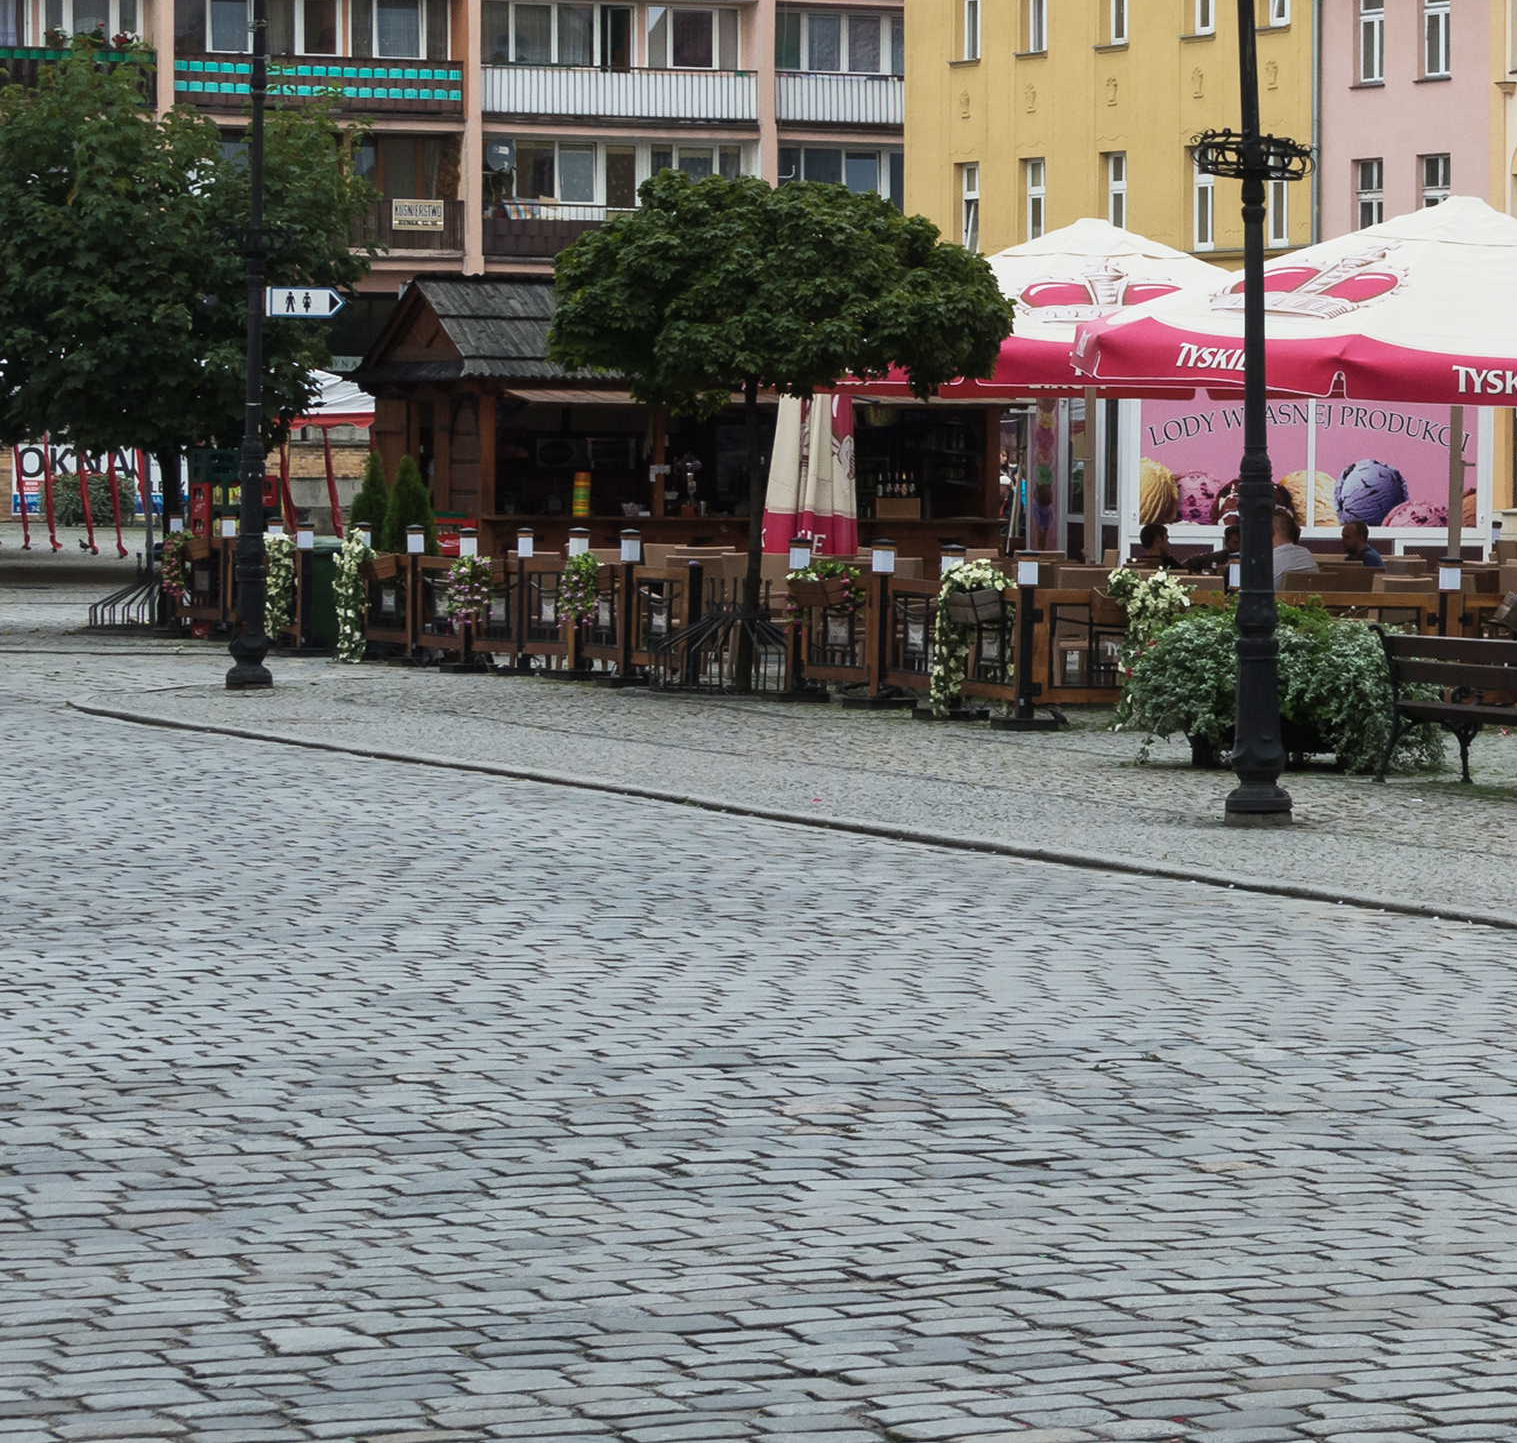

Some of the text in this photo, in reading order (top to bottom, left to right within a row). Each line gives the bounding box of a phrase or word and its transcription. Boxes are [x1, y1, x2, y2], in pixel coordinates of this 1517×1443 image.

[395, 203, 442, 217] KUŚNIERSTWO
[1149, 403, 1471, 454] LODY WASNEJ PRODUKCI
